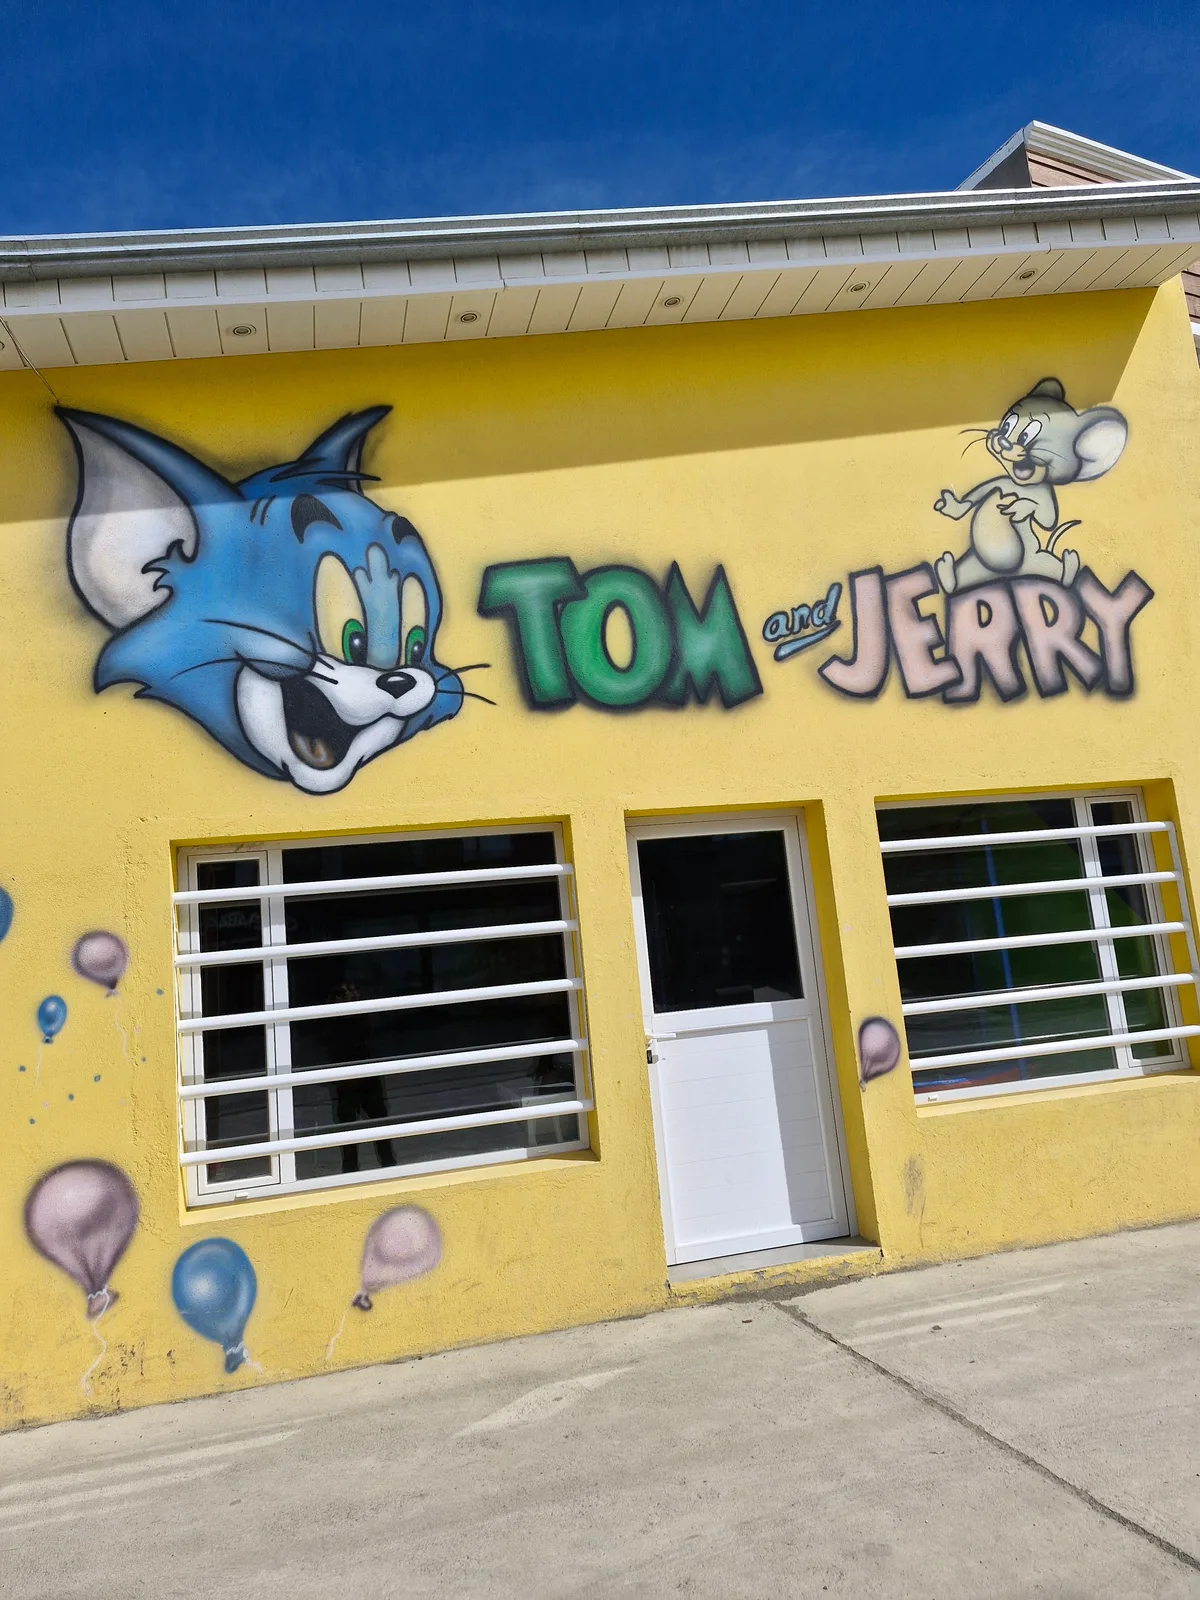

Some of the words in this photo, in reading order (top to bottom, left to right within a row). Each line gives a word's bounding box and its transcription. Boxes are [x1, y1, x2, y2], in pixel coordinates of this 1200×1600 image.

[478, 557, 763, 709] TOM
[762, 582, 842, 642] and
[818, 563, 1154, 702] JERRY
